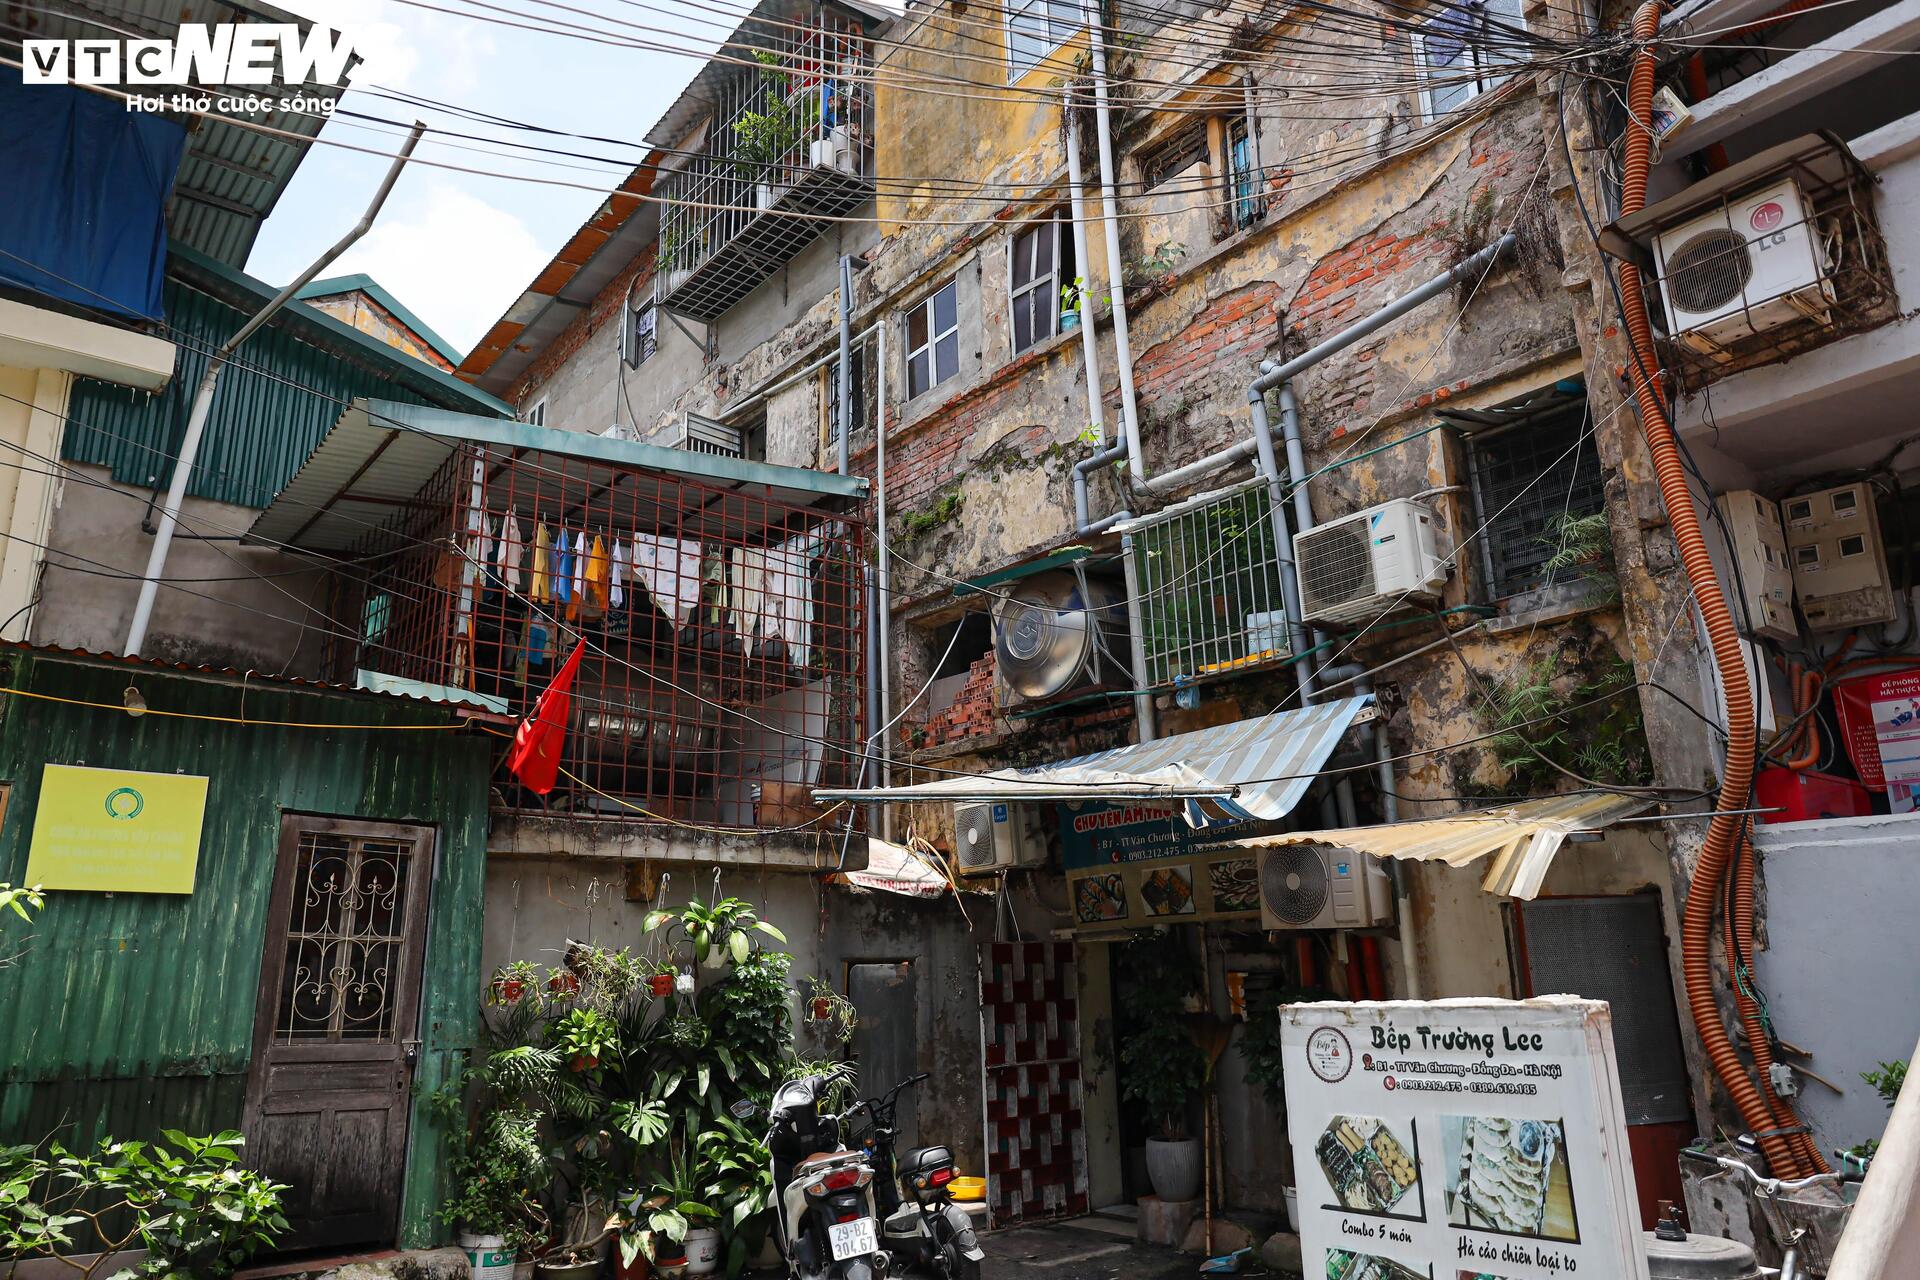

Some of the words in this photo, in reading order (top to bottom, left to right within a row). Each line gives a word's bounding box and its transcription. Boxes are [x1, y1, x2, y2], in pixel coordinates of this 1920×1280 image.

[1758, 232, 1787, 251] LG
[1074, 808, 1121, 832] CHUYÊN
[1128, 845, 1180, 862] 0903.212.475
[1370, 1021, 1411, 1055] Bếp
[1416, 1026, 1494, 1058] Trường
[1376, 1061, 1388, 1072] B1
[1408, 1062, 1427, 1073] Văn
[1427, 1062, 1465, 1077] Chương
[1472, 1060, 1500, 1078] Đống
[1501, 1064, 1517, 1075] Đa
[1524, 1064, 1540, 1076] Hà
[1542, 1064, 1562, 1079] Nội
[1401, 1081, 1462, 1092] 0903.212.475
[1470, 1082, 1537, 1095] 0389.619.185
[835, 1221, 868, 1242] 29-B2
[1341, 1218, 1375, 1238] Combo
[1379, 1224, 1386, 1239] 5
[1389, 1226, 1413, 1244] món
[834, 1236, 874, 1259] 304.67
[1457, 1235, 1475, 1259] Hà
[1478, 1240, 1498, 1261] cảo
[1501, 1242, 1532, 1266] chiên
[1536, 1249, 1561, 1276] loại
[1564, 1254, 1577, 1273] to
